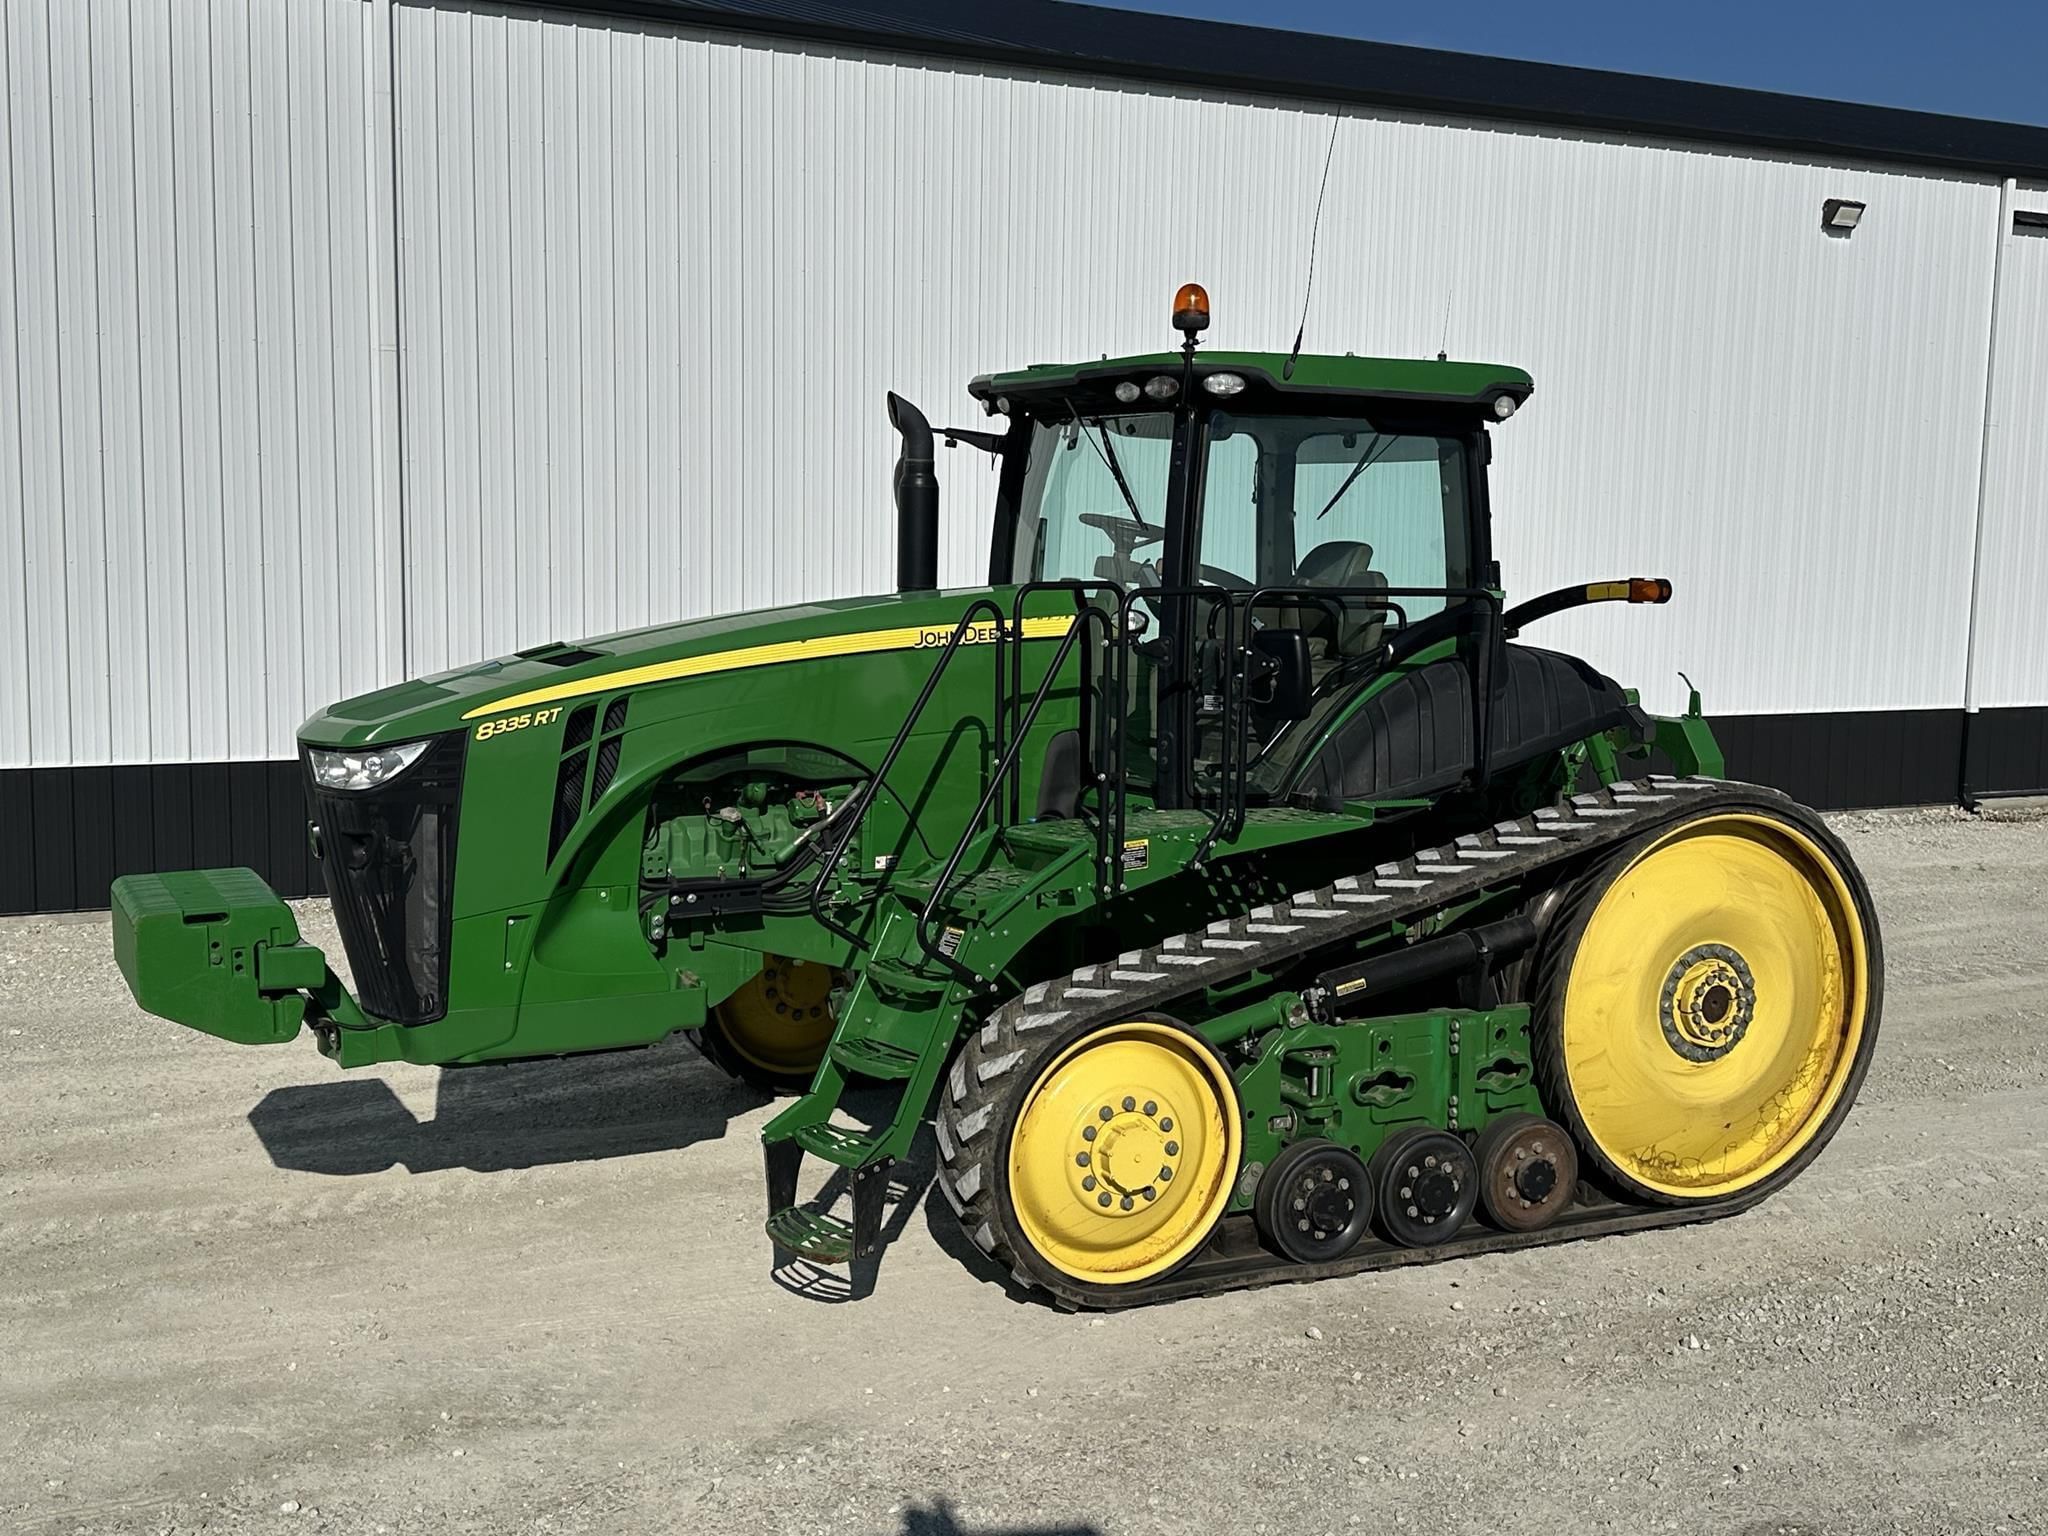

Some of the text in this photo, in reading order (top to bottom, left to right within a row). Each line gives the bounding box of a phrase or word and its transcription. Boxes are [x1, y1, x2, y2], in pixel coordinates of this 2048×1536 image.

[964, 626, 1024, 642] DEE
[475, 706, 563, 741] 8335 RT
